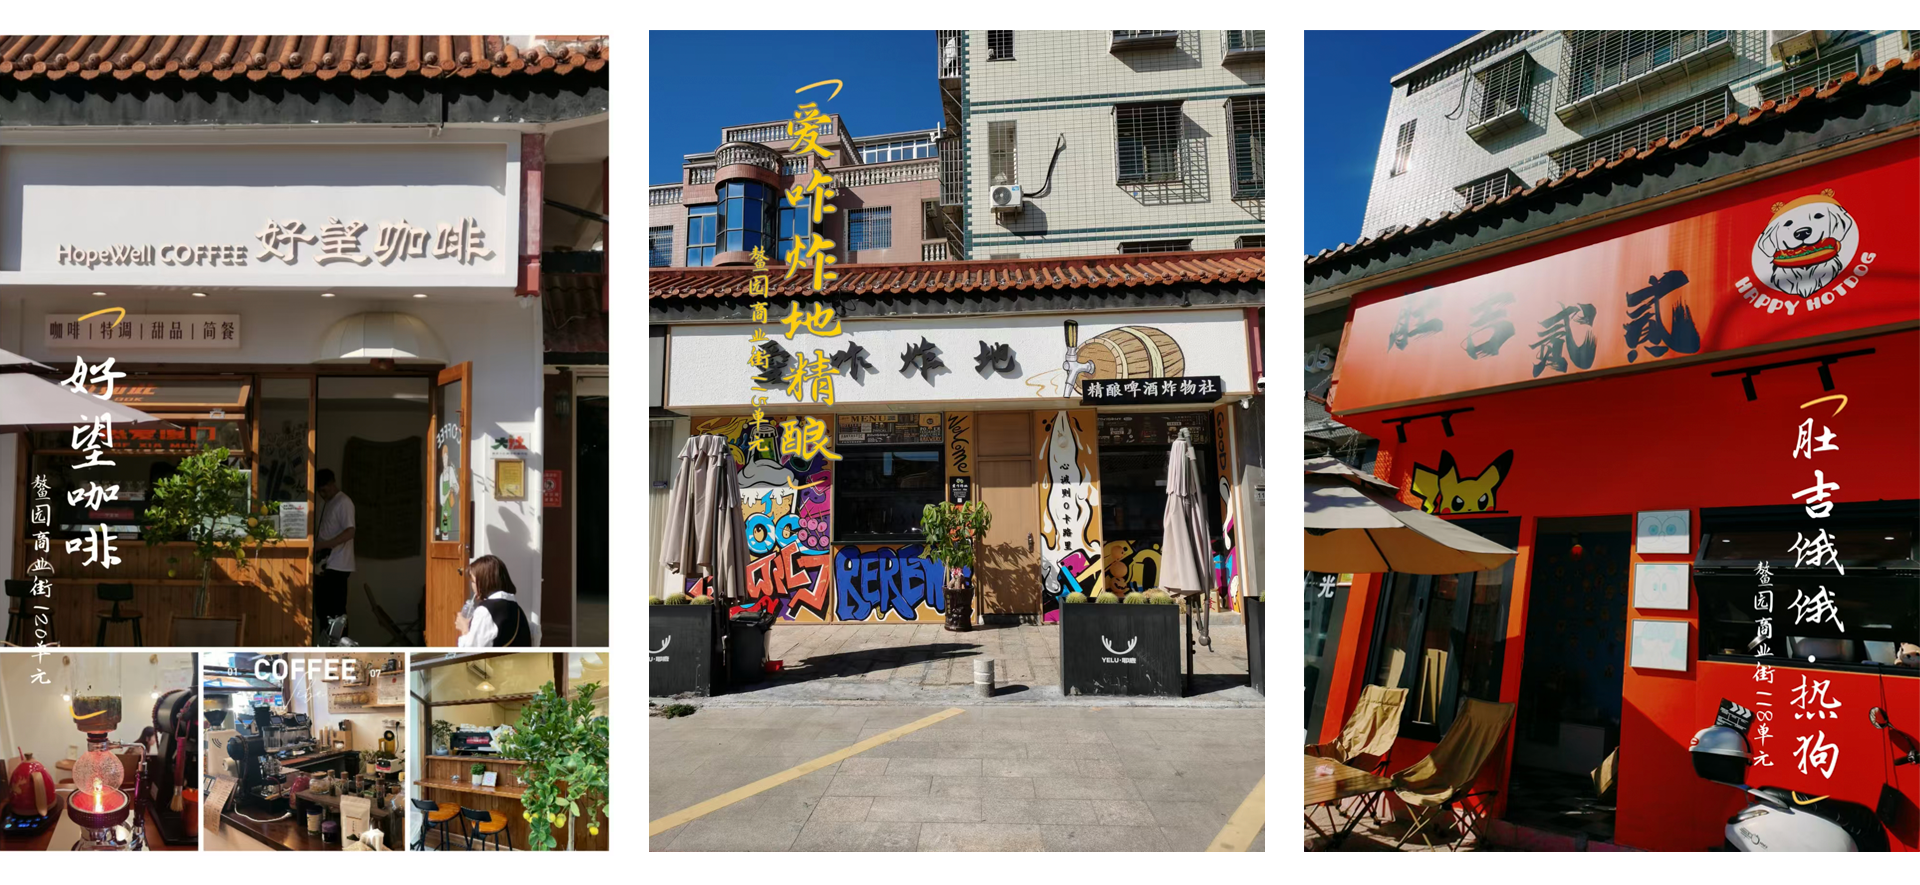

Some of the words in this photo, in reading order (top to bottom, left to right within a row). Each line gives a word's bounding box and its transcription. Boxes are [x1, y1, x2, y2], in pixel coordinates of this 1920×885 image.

[57, 243, 153, 269] HopeWell
[160, 244, 248, 267] COFFEE
[255, 216, 496, 266] 好望咖啡
[1735, 276, 1800, 316] HAPPY
[1806, 251, 1877, 312] HOTDOG
[50, 320, 81, 340] 咖啡
[100, 320, 132, 340] 特调
[151, 320, 183, 340] 甜品
[203, 320, 235, 340] 简餐
[1086, 379, 1218, 398] 精酿啤酒炸物社
[851, 415, 887, 423] MENU
[1316, 574, 1336, 598] 光
